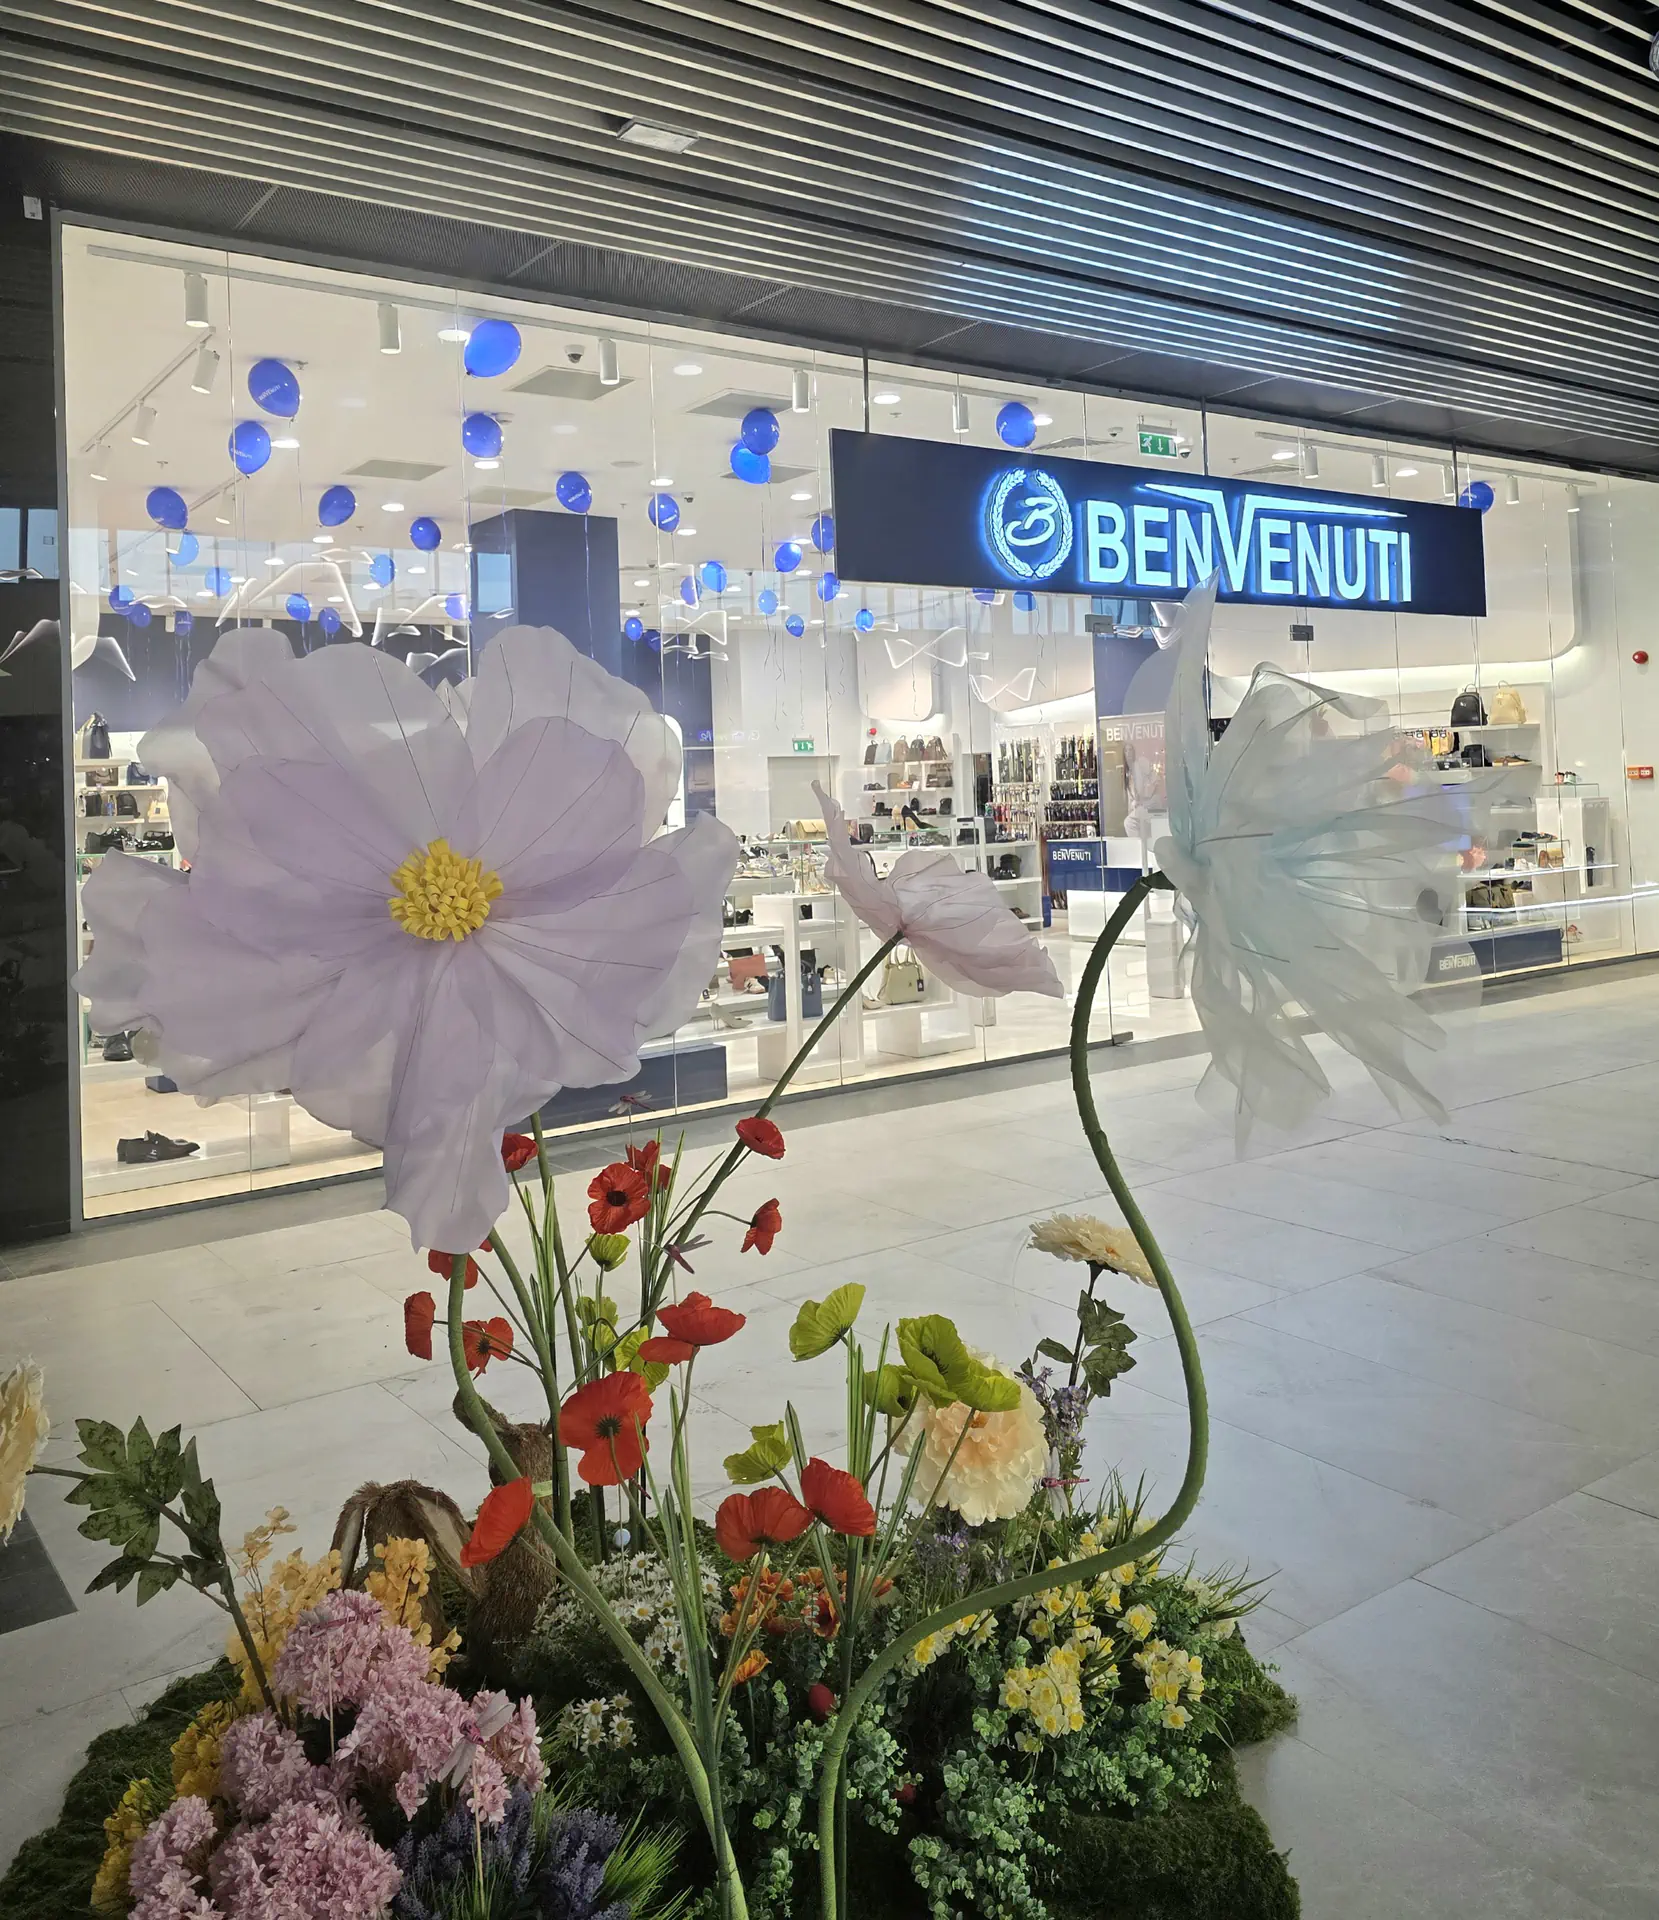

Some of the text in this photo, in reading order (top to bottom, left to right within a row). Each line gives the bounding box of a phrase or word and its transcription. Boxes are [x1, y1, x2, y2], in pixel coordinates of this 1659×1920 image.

[1086, 483, 1412, 602] BENVENUTI
[1106, 721, 1165, 742] BENVENUT
[1052, 848, 1091, 861] BENVENUTI
